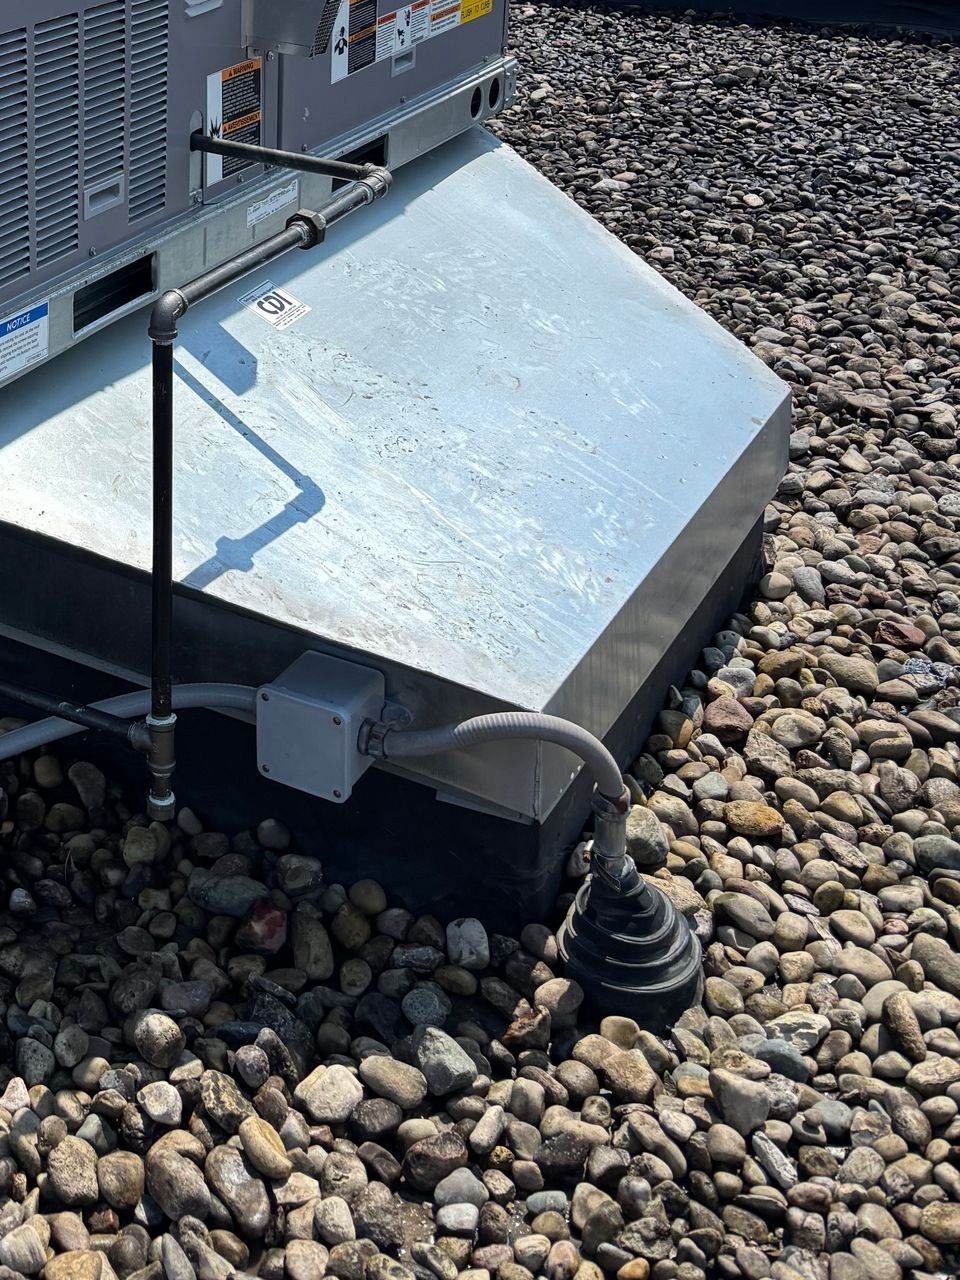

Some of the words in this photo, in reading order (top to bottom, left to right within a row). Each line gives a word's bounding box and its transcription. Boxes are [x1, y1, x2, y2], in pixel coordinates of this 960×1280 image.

[233, 62, 254, 76] WARNING
[257, 291, 293, 315] CDI
[7, 314, 31, 331] NOTICE
